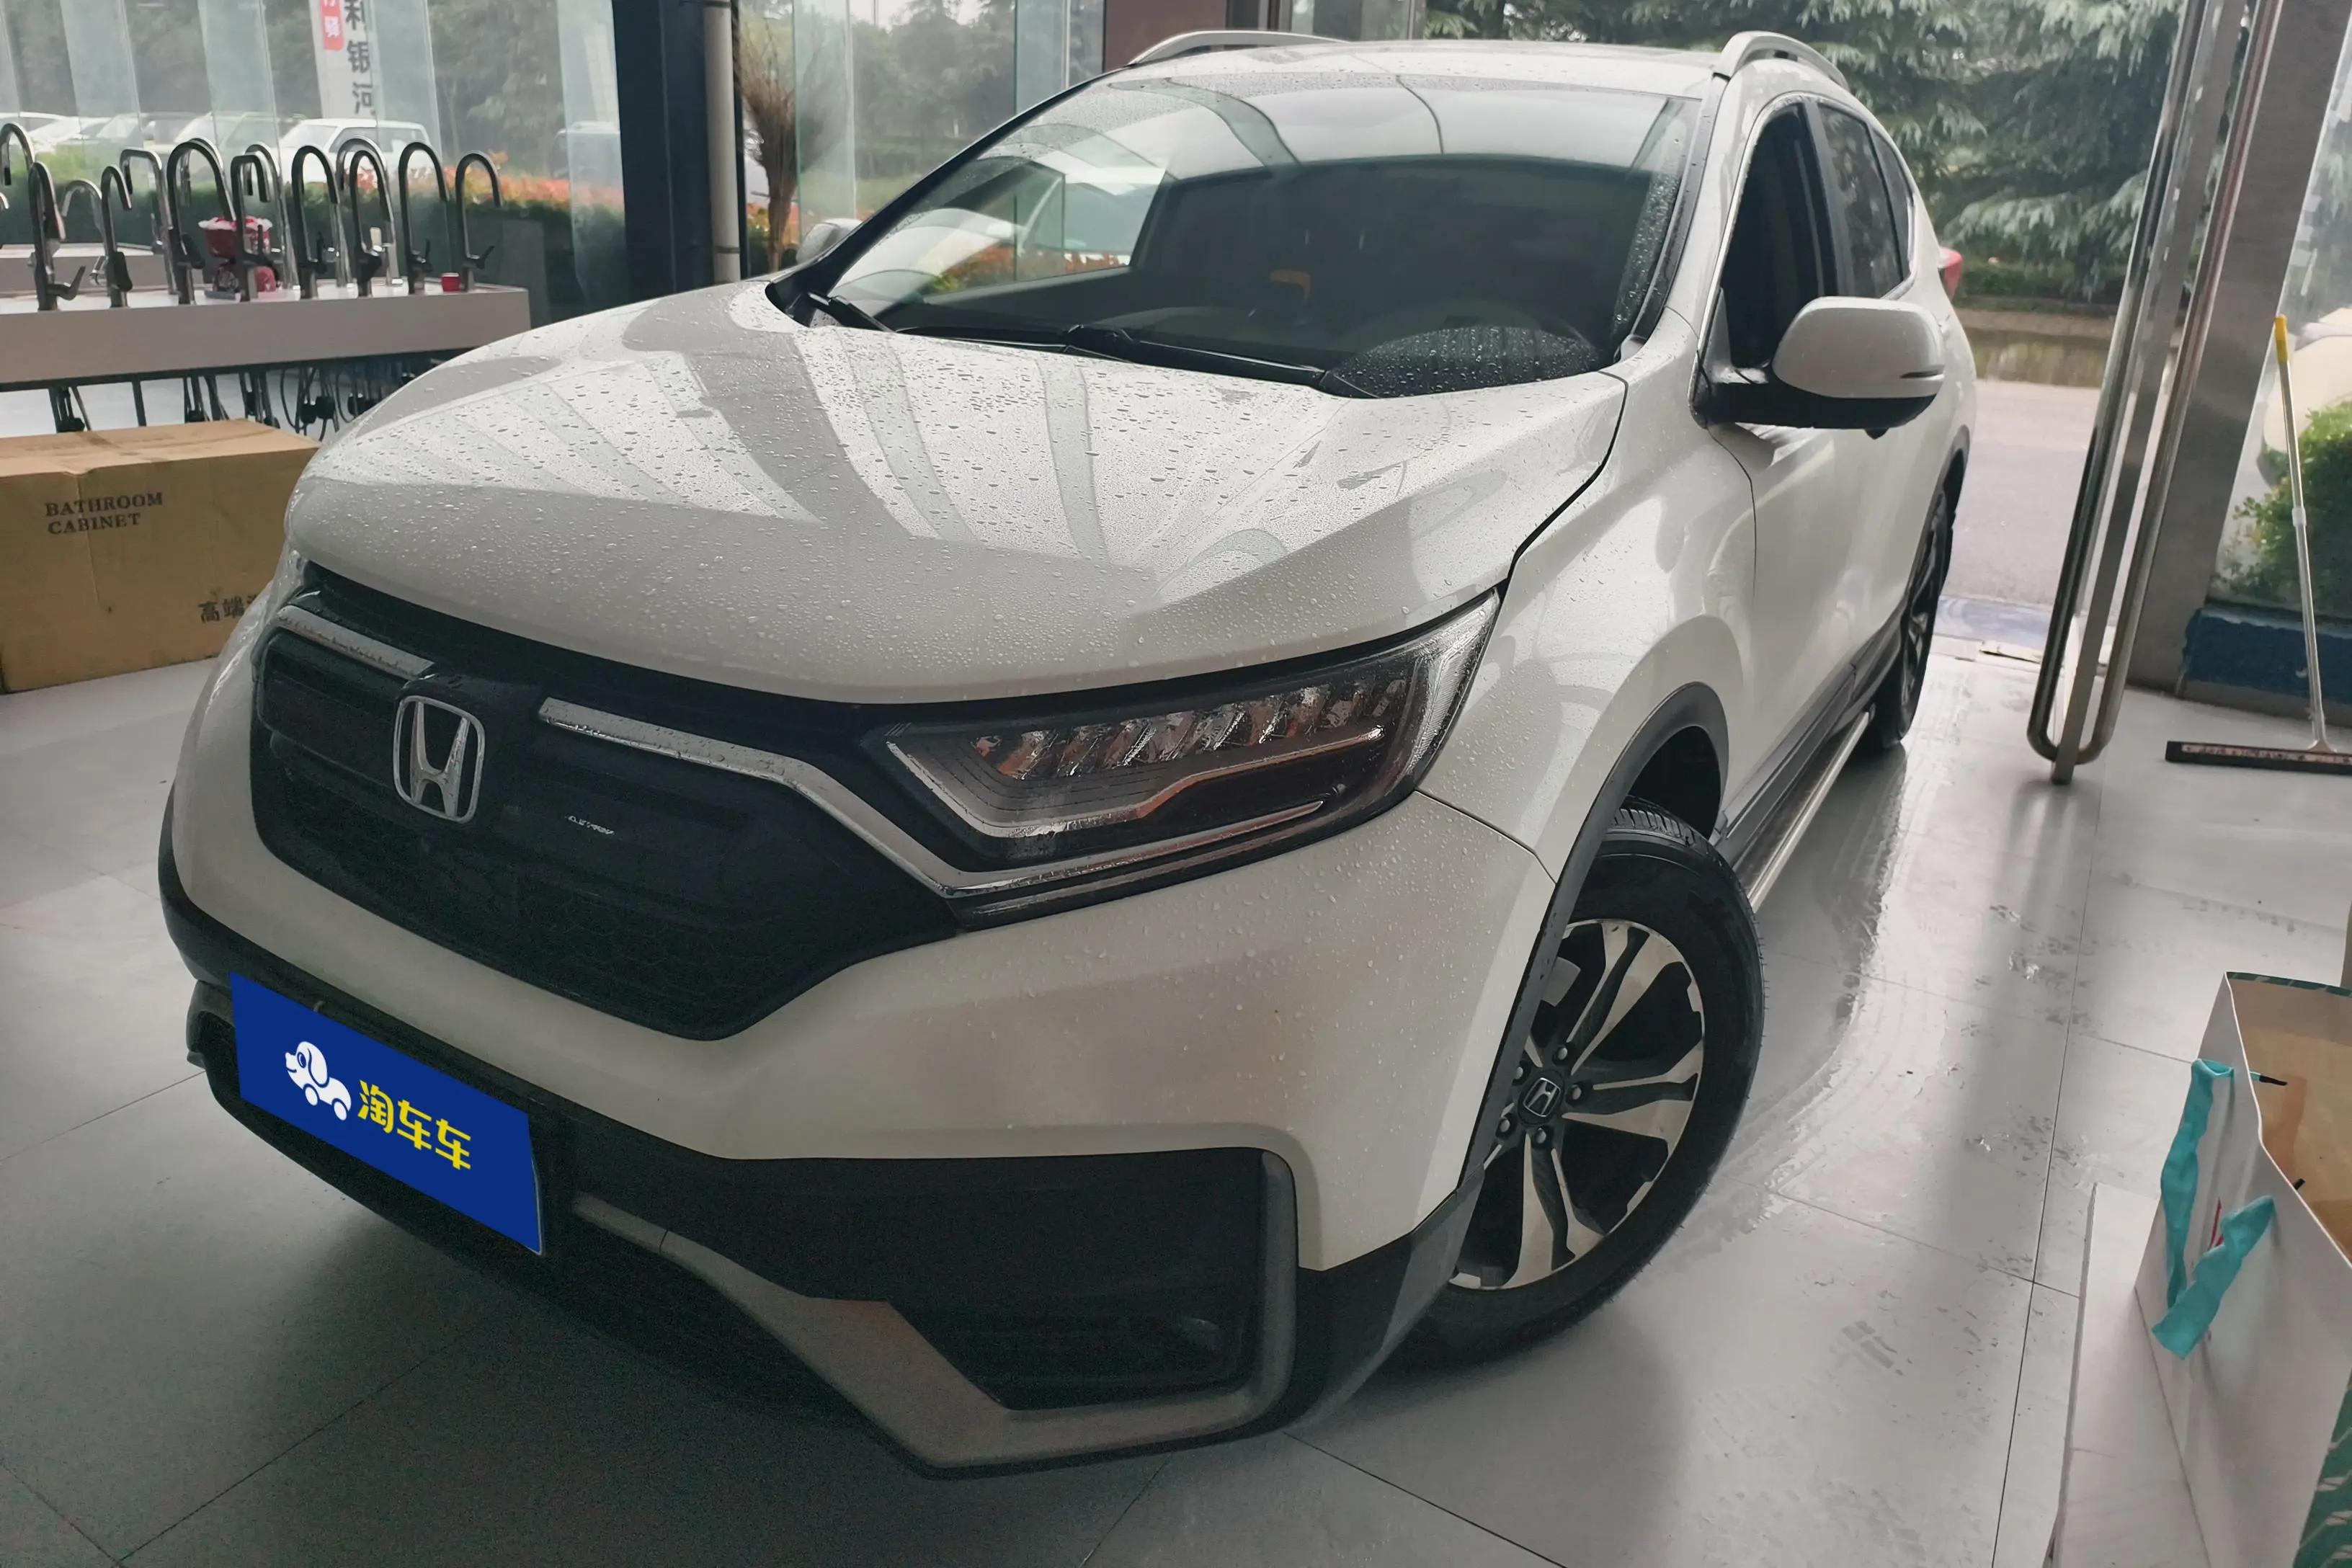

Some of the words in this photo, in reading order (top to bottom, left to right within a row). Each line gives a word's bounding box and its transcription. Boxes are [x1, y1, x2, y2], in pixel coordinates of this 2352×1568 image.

[45, 492, 163, 517] BATHROOM
[48, 512, 141, 535] CABINET
[197, 594, 257, 624] 高端
